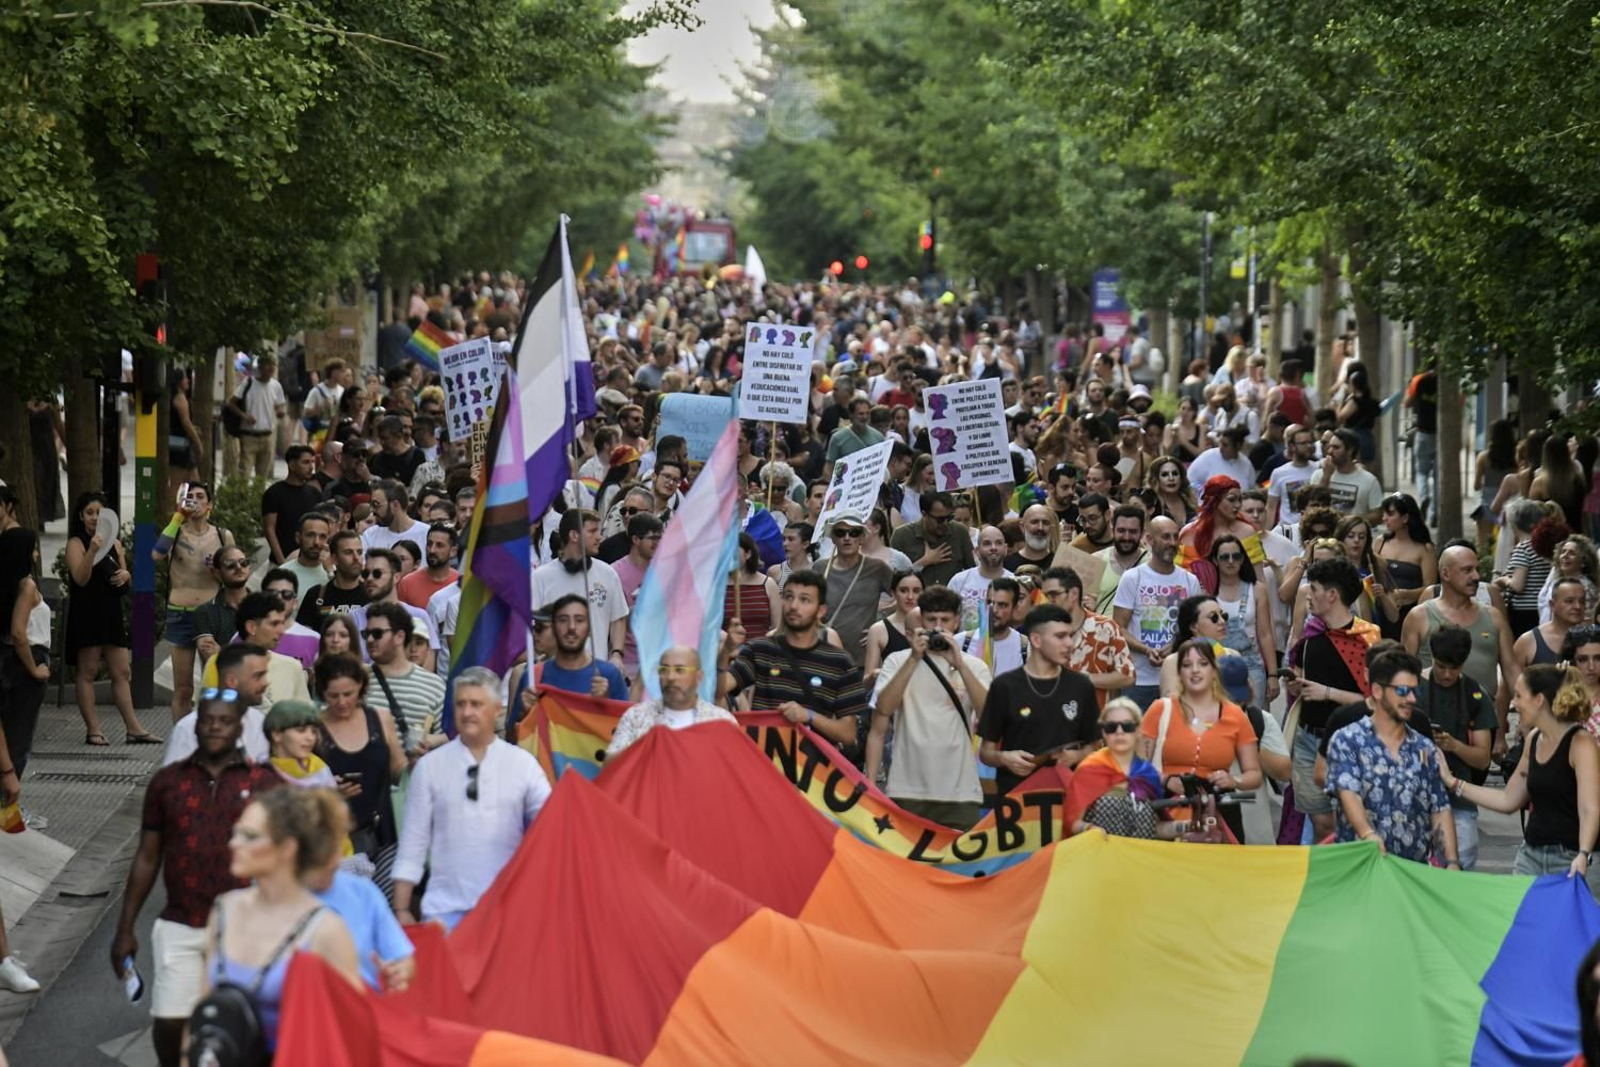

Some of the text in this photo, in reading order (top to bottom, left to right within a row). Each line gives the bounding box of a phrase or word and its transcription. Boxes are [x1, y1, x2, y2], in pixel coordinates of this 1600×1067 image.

[444, 354, 459, 365] MEJOR
[460, 352, 467, 360] EN
[468, 347, 485, 358] COLOR
[769, 362, 795, 370] DISFRUTAR
[751, 383, 799, 393] #EDUCACIÓNSEXUAL
[966, 394, 988, 402] POLÍTICAS
[766, 406, 789, 415] AUSENCIA
[956, 405, 977, 413] PROTEJAN
[963, 423, 983, 431] LIBERTAD
[966, 441, 994, 450] DESARROLLO
[969, 451, 991, 459] POLÍTICAS
[961, 462, 983, 470] EXCLUYEN
[971, 469, 1000, 478] SUFRIMIENTO
[960, 589, 988, 599] SOL
[1140, 585, 1170, 597] SOLO
[1138, 596, 1158, 606] LOS
[1160, 620, 1179, 634] NO
[1140, 632, 1174, 643] CALLAR
[746, 725, 868, 812] NTO
